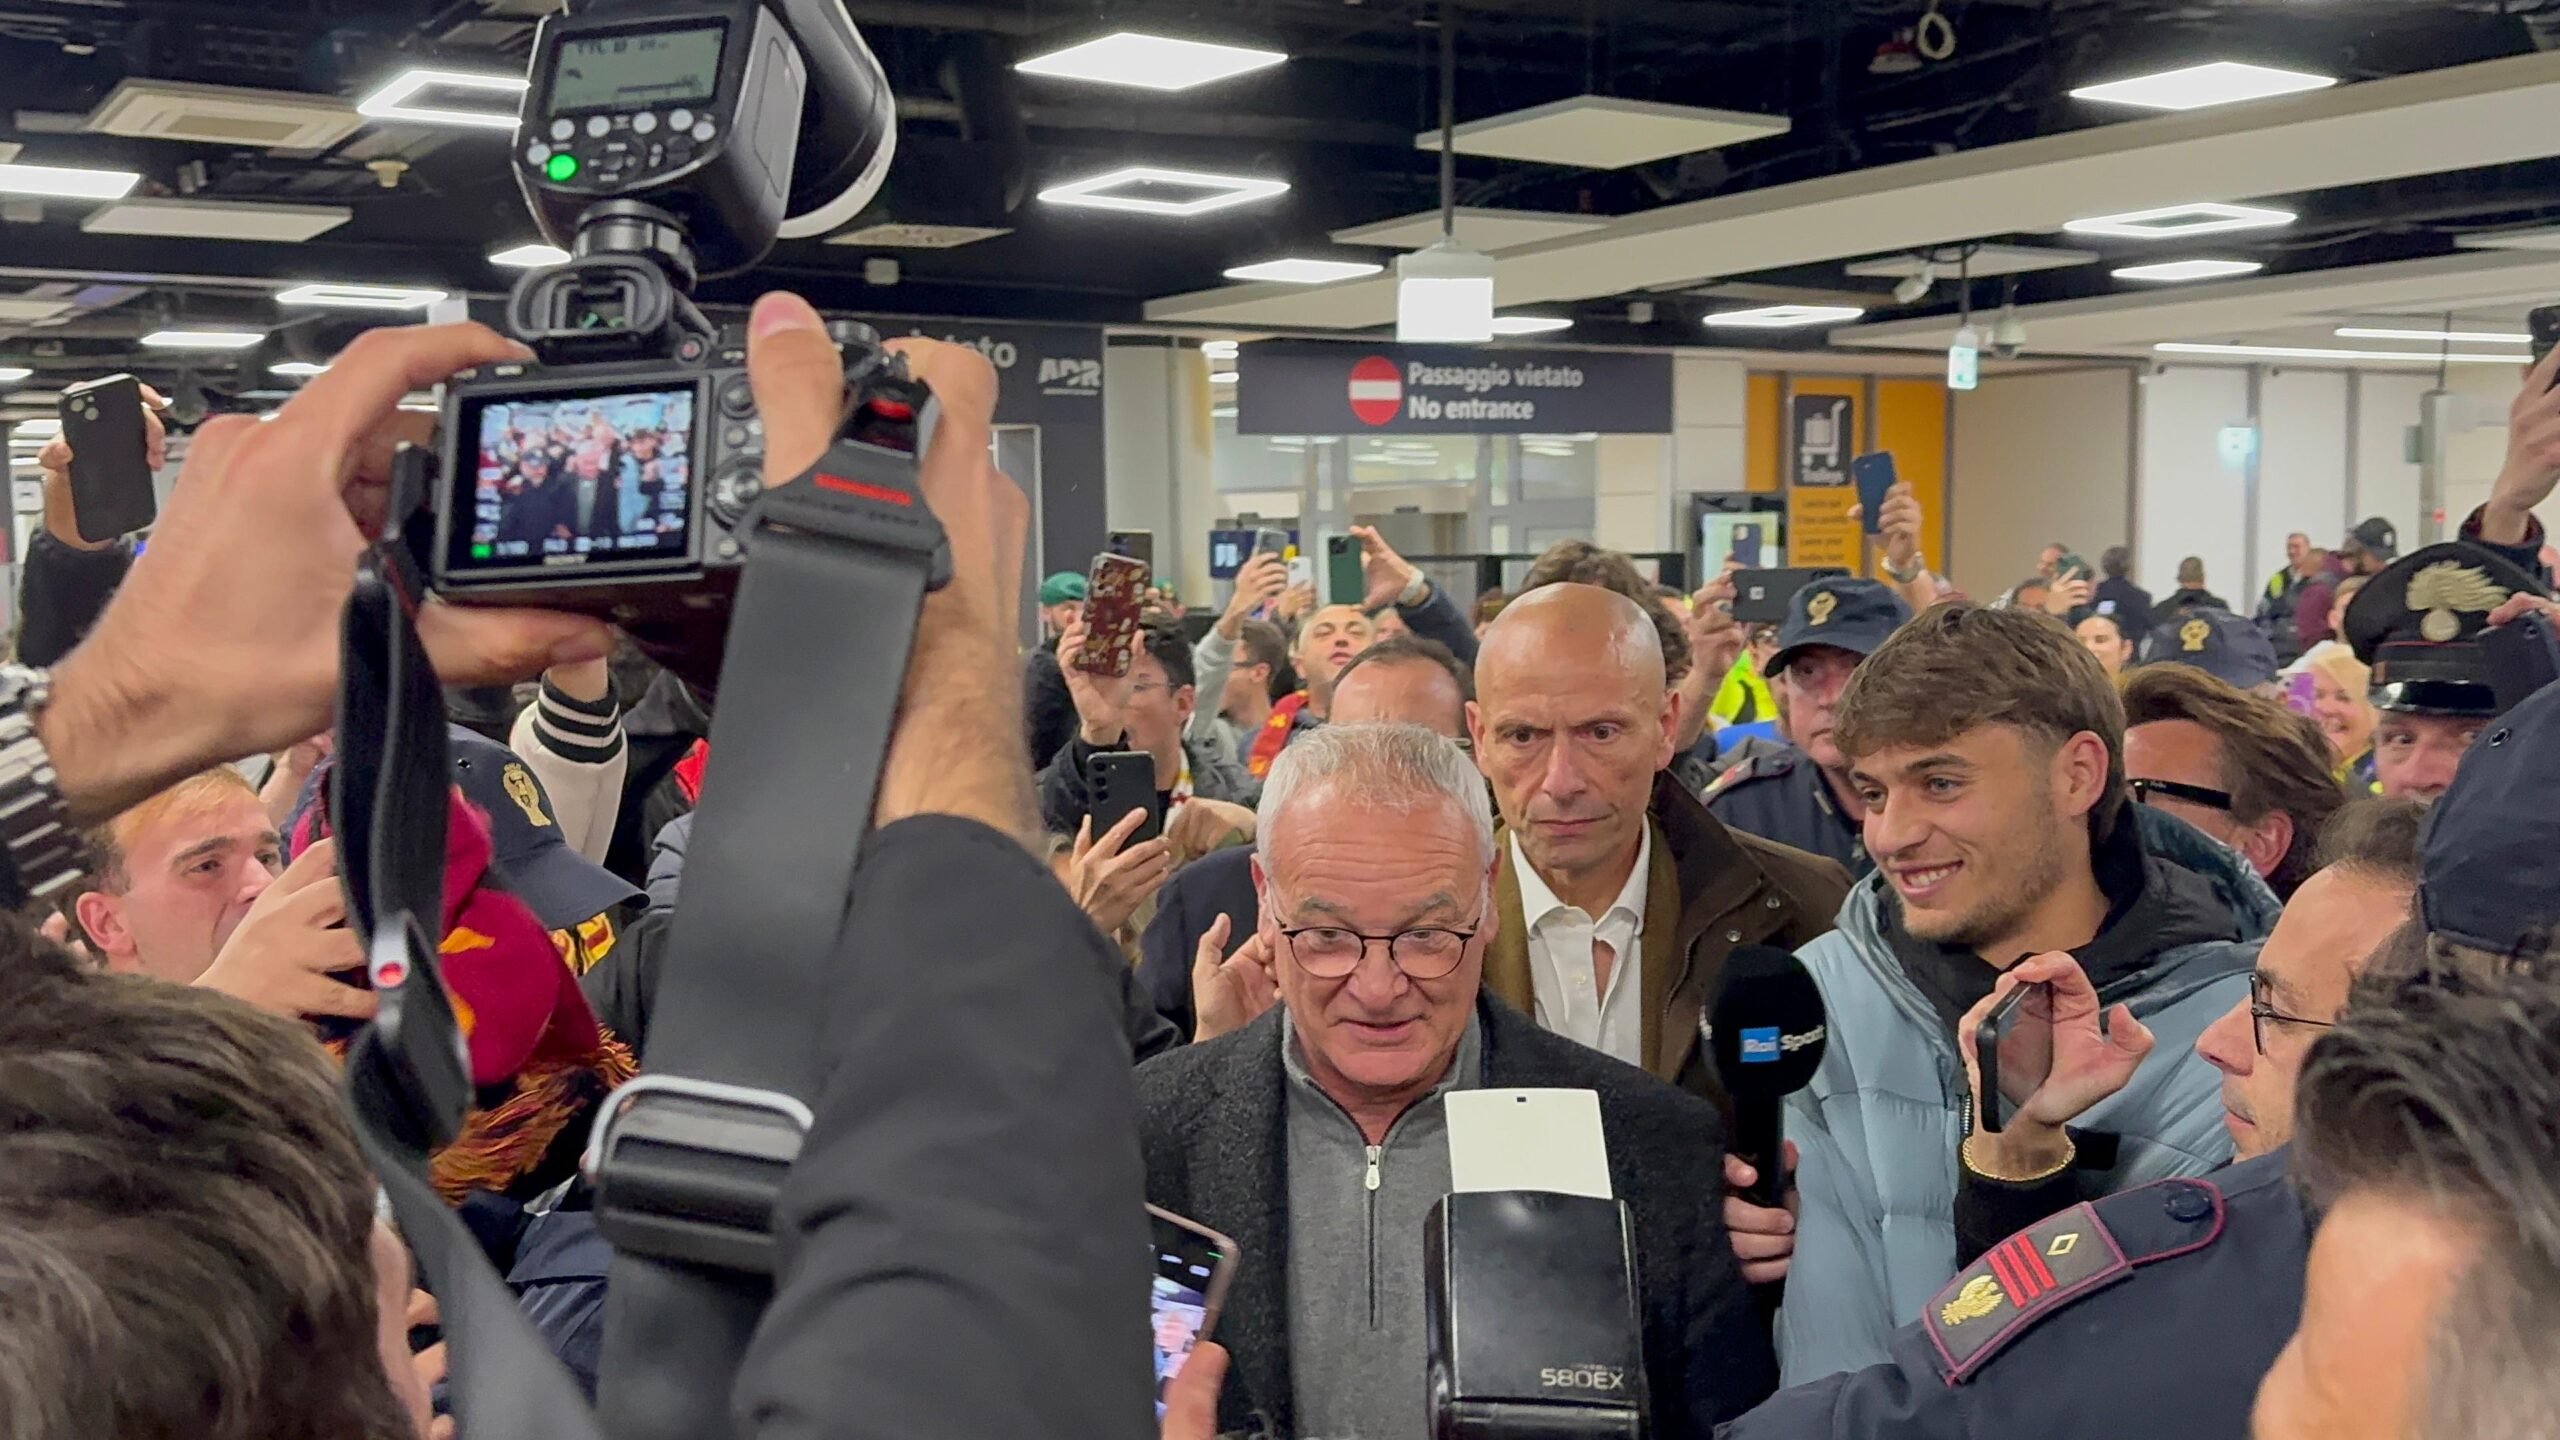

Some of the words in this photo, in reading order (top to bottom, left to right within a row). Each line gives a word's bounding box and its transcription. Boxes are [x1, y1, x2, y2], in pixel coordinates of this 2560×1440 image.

[1037, 357, 1101, 387] ADR
[1408, 361, 1511, 393] Passaggio
[1514, 362, 1584, 388] vietato
[1408, 396, 1442, 420] No
[1445, 398, 1535, 420] entrance
[1743, 1036, 1777, 1053] Rai
[1541, 1367, 1625, 1391] 580EX
